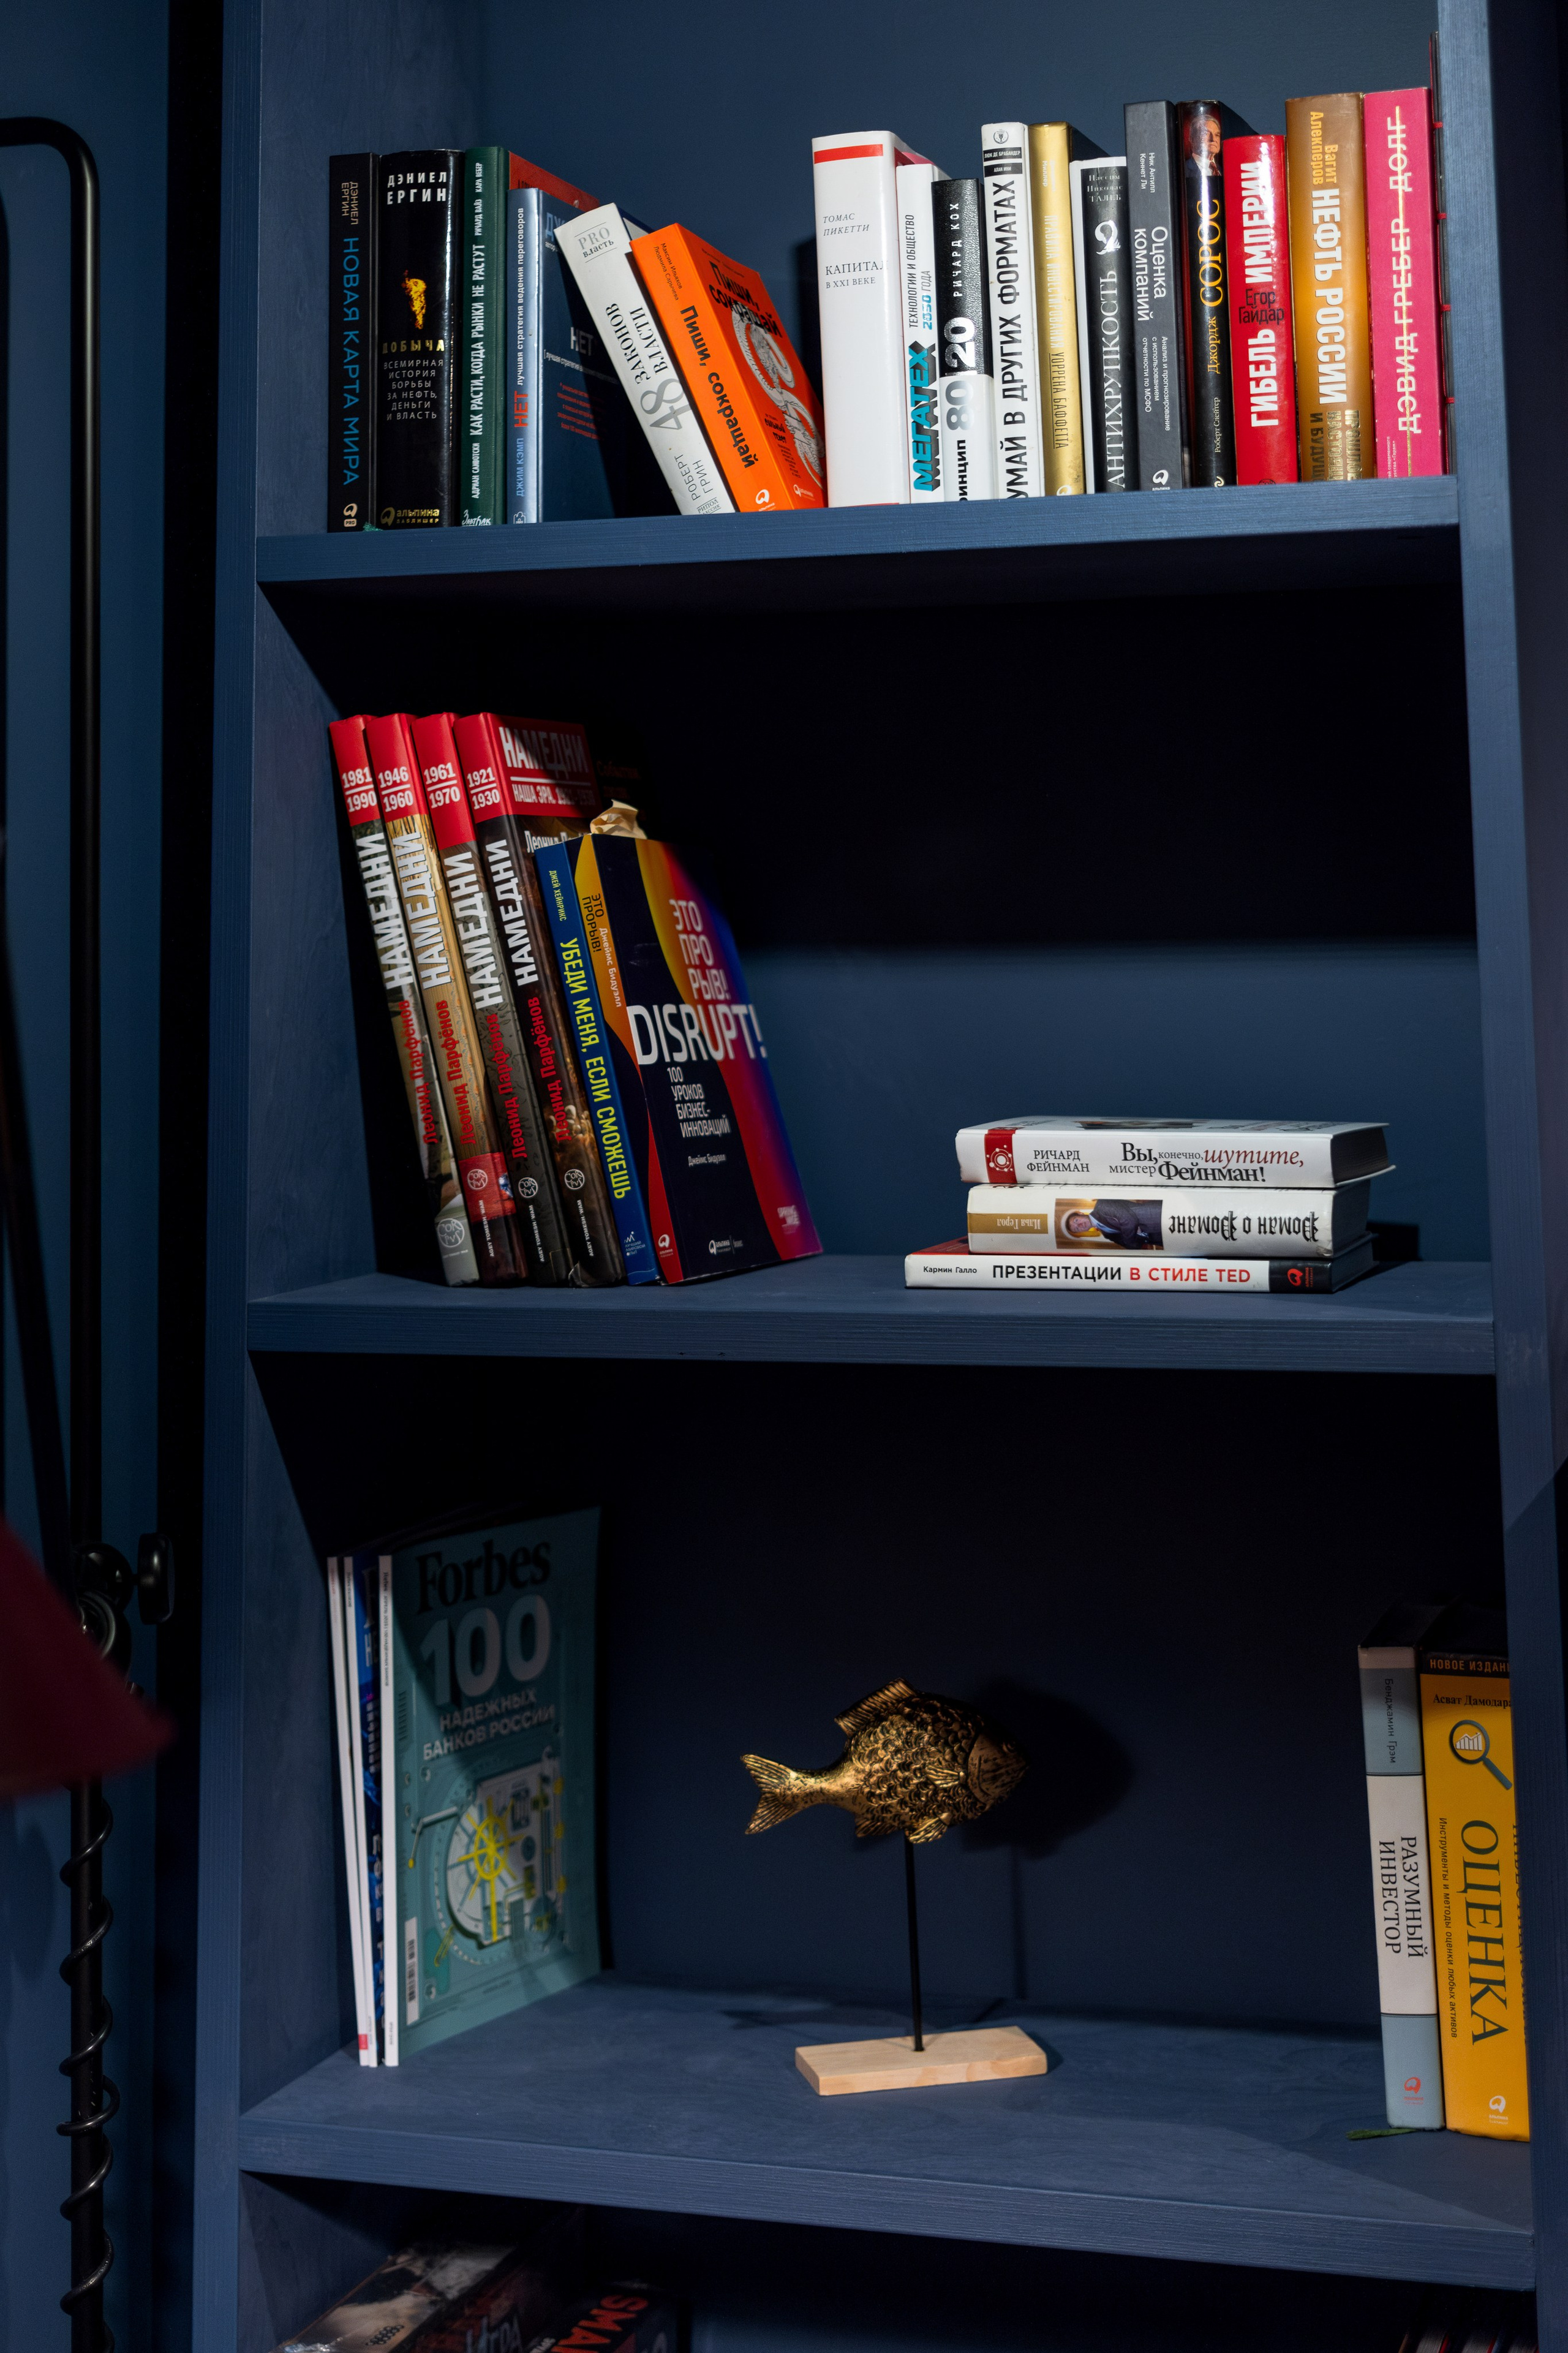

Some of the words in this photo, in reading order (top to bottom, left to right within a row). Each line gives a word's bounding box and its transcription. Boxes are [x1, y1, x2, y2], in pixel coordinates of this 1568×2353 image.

[1310, 111, 1324, 185] Алекперов
[1324, 145, 1338, 183] Вагит
[1387, 117, 1413, 192] ДОЛГ
[341, 182, 350, 216] ЕРГИН
[386, 188, 447, 205] ЕРГИН
[388, 172, 447, 188] ДЭНИЕЛ
[350, 182, 359, 225] ДЭНИЕЛ
[823, 213, 855, 224] ТОМАС
[949, 202, 960, 230] КОХ
[1240, 161, 1273, 284] ИМПЕРИИ
[474, 214, 483, 236] РИЧАРД
[517, 208, 526, 265] переговоров
[578, 227, 610, 250] PRO
[823, 224, 870, 236] ПИКЕТТИ
[905, 214, 916, 260] ОБЩЕСТВО
[992, 180, 1019, 305] ФОРМАТАХ
[1044, 216, 1061, 260] ПРАВИЛА
[1312, 188, 1342, 281] НЕФТЬ
[472, 244, 486, 281] РАСТУТ
[582, 238, 614, 259] власть
[661, 243, 673, 265] Максим
[671, 265, 682, 289] Ильяхов
[1150, 227, 1168, 299] Оценка
[1197, 199, 1223, 307] СОРОС
[343, 238, 360, 321] НОВАЯ
[654, 246, 668, 272] Людмила
[665, 273, 679, 301] Сарычева
[852, 277, 876, 285] ВЕКЕ
[921, 271, 931, 292] ГОДА
[951, 240, 963, 298] РИЧАРД
[1134, 229, 1154, 321] компаний
[1390, 217, 1413, 325] ГРЕБЕР
[472, 284, 484, 297] НЕ
[907, 273, 918, 328] ТЕХНОЛОГИИ
[1046, 263, 1065, 349] ИНВЕСТИРОВАНИЯ
[1245, 289, 1275, 307] Егор
[471, 302, 484, 338] РЫНКИ
[1238, 306, 1285, 325] Гайдар
[470, 342, 486, 375] КОГДА
[605, 303, 652, 385] ЗАКОНОВ
[628, 306, 669, 376] ВЛАСТИ
[999, 314, 1028, 401] ДРУГИХ
[1208, 316, 1221, 374] Джордж
[1316, 287, 1347, 404] РОССИИ
[343, 331, 360, 409] КАРТА
[383, 358, 444, 370] ВСЕМИРНАЯ
[388, 369, 435, 379] ИСТОРИЯ
[1051, 352, 1066, 393] УОРРЕНА
[1099, 271, 1125, 488] АНТИХРУПКОСТЬ
[1152, 342, 1160, 401] использованием
[1248, 329, 1279, 427] ГИБЕЛЬ
[1395, 333, 1422, 434] ДЭВИД
[392, 379, 431, 390] БОРЬБЫ
[470, 376, 485, 410] РАСТИ,
[680, 305, 710, 366] Пиши,
[707, 372, 758, 468] сокращай
[1162, 370, 1171, 431] прогнозирование
[391, 400, 431, 411] ДЕНЬГИ
[397, 411, 437, 420] ВЛАСТЬ
[514, 391, 528, 427] НЕТ
[639, 378, 694, 431] 48
[908, 340, 940, 491] МЕГАТЕХ
[1003, 411, 1025, 425] В
[1054, 398, 1069, 449] БАФФЕТТА
[470, 414, 483, 436] КАК
[343, 417, 360, 486] МИРА
[472, 475, 480, 499] АДРИАН
[516, 467, 525, 497] ДЖИМ
[674, 454, 701, 501] РОБЕРТ
[692, 460, 714, 494] ГРИН
[341, 767, 372, 788] 1981
[378, 766, 409, 788] 1946
[423, 762, 456, 785] 1961
[467, 767, 495, 788] 1921
[347, 790, 377, 813] 1990
[383, 790, 414, 812] 1960
[429, 786, 461, 809] 1970
[471, 789, 500, 810] 1930
[549, 871, 560, 889] ДЖЕЙ
[356, 832, 413, 991] НАМЕДНИ
[392, 832, 453, 989] НАМЕДНИ
[485, 839, 539, 986] НАМЕДНИ
[554, 889, 567, 921] ХЕЙНРИКС
[582, 897, 601, 952] ПРОРЫВ!
[592, 893, 603, 918] ЭТО
[669, 899, 704, 932] ЭТО
[443, 851, 503, 1010] НАМЕДНИ
[678, 933, 715, 966] ПРО
[560, 937, 587, 994] УБЕДИ
[599, 927, 613, 966] Джеймс
[608, 967, 622, 1007] Бидуэлл
[687, 967, 731, 1000] РЫВ!
[399, 1000, 424, 1080] Парфёнов
[436, 1000, 461, 1082] Парфёнов
[528, 996, 557, 1079] Парфёнов
[573, 997, 599, 1052] МЕНЯ,
[627, 1003, 768, 1065] DISRUPT!
[487, 1013, 512, 1095] Парфёнов
[586, 1056, 611, 1103] ЕСЛИ
[667, 1067, 684, 1082] 100
[671, 1083, 705, 1101] УРОКОВ
[414, 1082, 439, 1144] Леонид
[453, 1082, 477, 1147] Леонид
[502, 1095, 527, 1159] Леонид
[548, 1079, 572, 1142] Леонид
[676, 1101, 711, 1120] БИЗНЕС-
[679, 1114, 732, 1139] ИННОВАЦИЙ
[597, 1107, 631, 1199] СМОЖЕШЬ
[1027, 1160, 1090, 1173] ФЕЙНМАН
[1033, 1150, 1080, 1162] РИЧАРД
[1109, 1165, 1156, 1177] мистер
[1158, 1161, 1265, 1182] Фейнман!
[1120, 1143, 1158, 1164] Вы,
[1158, 1151, 1203, 1161] конечно,
[1203, 1149, 1303, 1169] шутите,
[997, 1216, 1019, 1229] Герол
[1020, 1218, 1041, 1229] Илья
[1168, 1210, 1238, 1241] Романе
[1242, 1215, 1251, 1233] о
[1257, 1212, 1318, 1242] Роман
[992, 1265, 1121, 1282] ПРЕЗЕНТАЦИИ
[1130, 1268, 1140, 1280] В
[1148, 1267, 1208, 1282] СТИЛЕ
[1216, 1268, 1250, 1282] TED
[415, 1538, 551, 1615] Forbes
[420, 1593, 551, 1707] 100
[1430, 1658, 1465, 1671] НОВОЕ
[440, 1686, 538, 1732] НАДЕЖНЫХ
[1385, 1678, 1395, 1736] Бенджамин
[1433, 1693, 1461, 1705] Асват
[423, 1727, 488, 1761] БАНКОВ
[489, 1704, 556, 1743] РОССИИ
[1387, 1741, 1397, 1763] Грэм
[1439, 1817, 1450, 1881] Инструменты
[1379, 1841, 1401, 1954] ИНВЕСТОР
[1401, 1836, 1428, 1958] РАЗУМНЫЙ
[1444, 1892, 1452, 1928] методы
[1445, 1932, 1454, 1965] оценки
[1457, 1819, 1509, 2045] ОЦЕНКА
[1448, 1968, 1459, 1999] любых
[1449, 2001, 1457, 2038] активов
